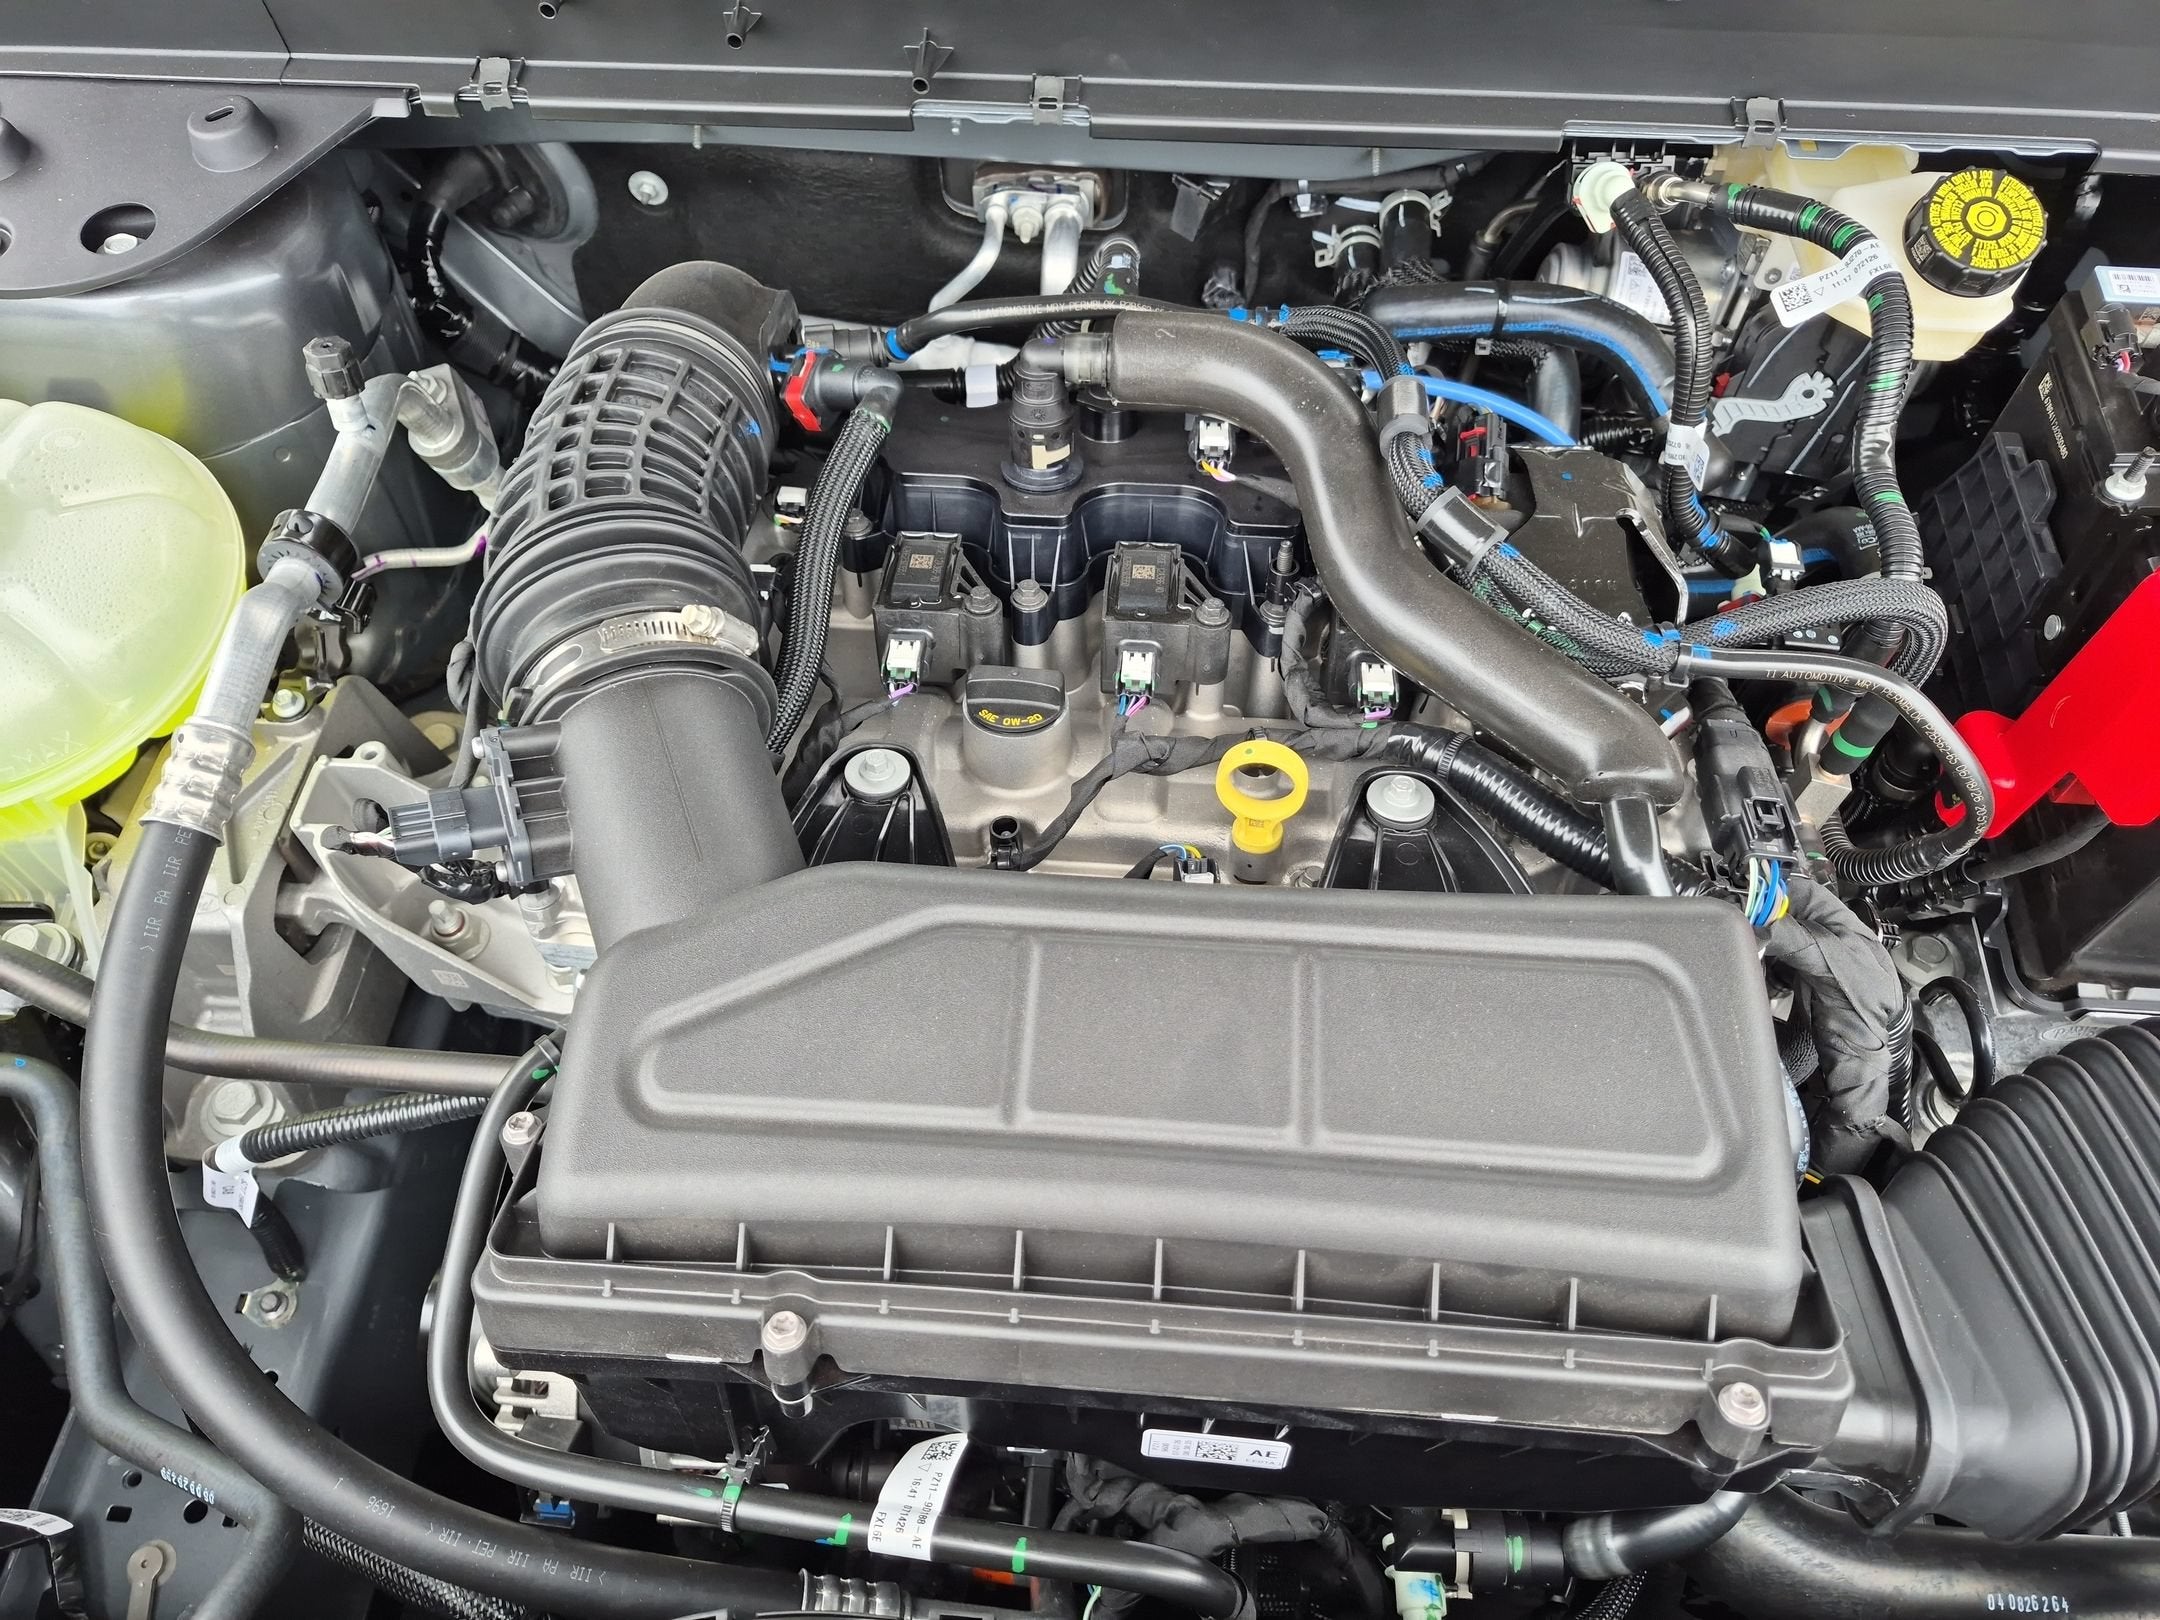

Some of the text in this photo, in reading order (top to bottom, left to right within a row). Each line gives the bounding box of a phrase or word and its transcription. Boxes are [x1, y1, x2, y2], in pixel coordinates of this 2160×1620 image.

[1950, 172, 1972, 186] FLUID
[1978, 170, 1992, 179] DOT
[1766, 669, 1777, 679] TI
[1783, 670, 1850, 685] AUTOMOTIVE
[1855, 679, 1880, 691] MRY
[1882, 687, 1926, 723] PERMBLOK
[978, 709, 999, 723] SAE
[1250, 1449, 1279, 1459] AE
